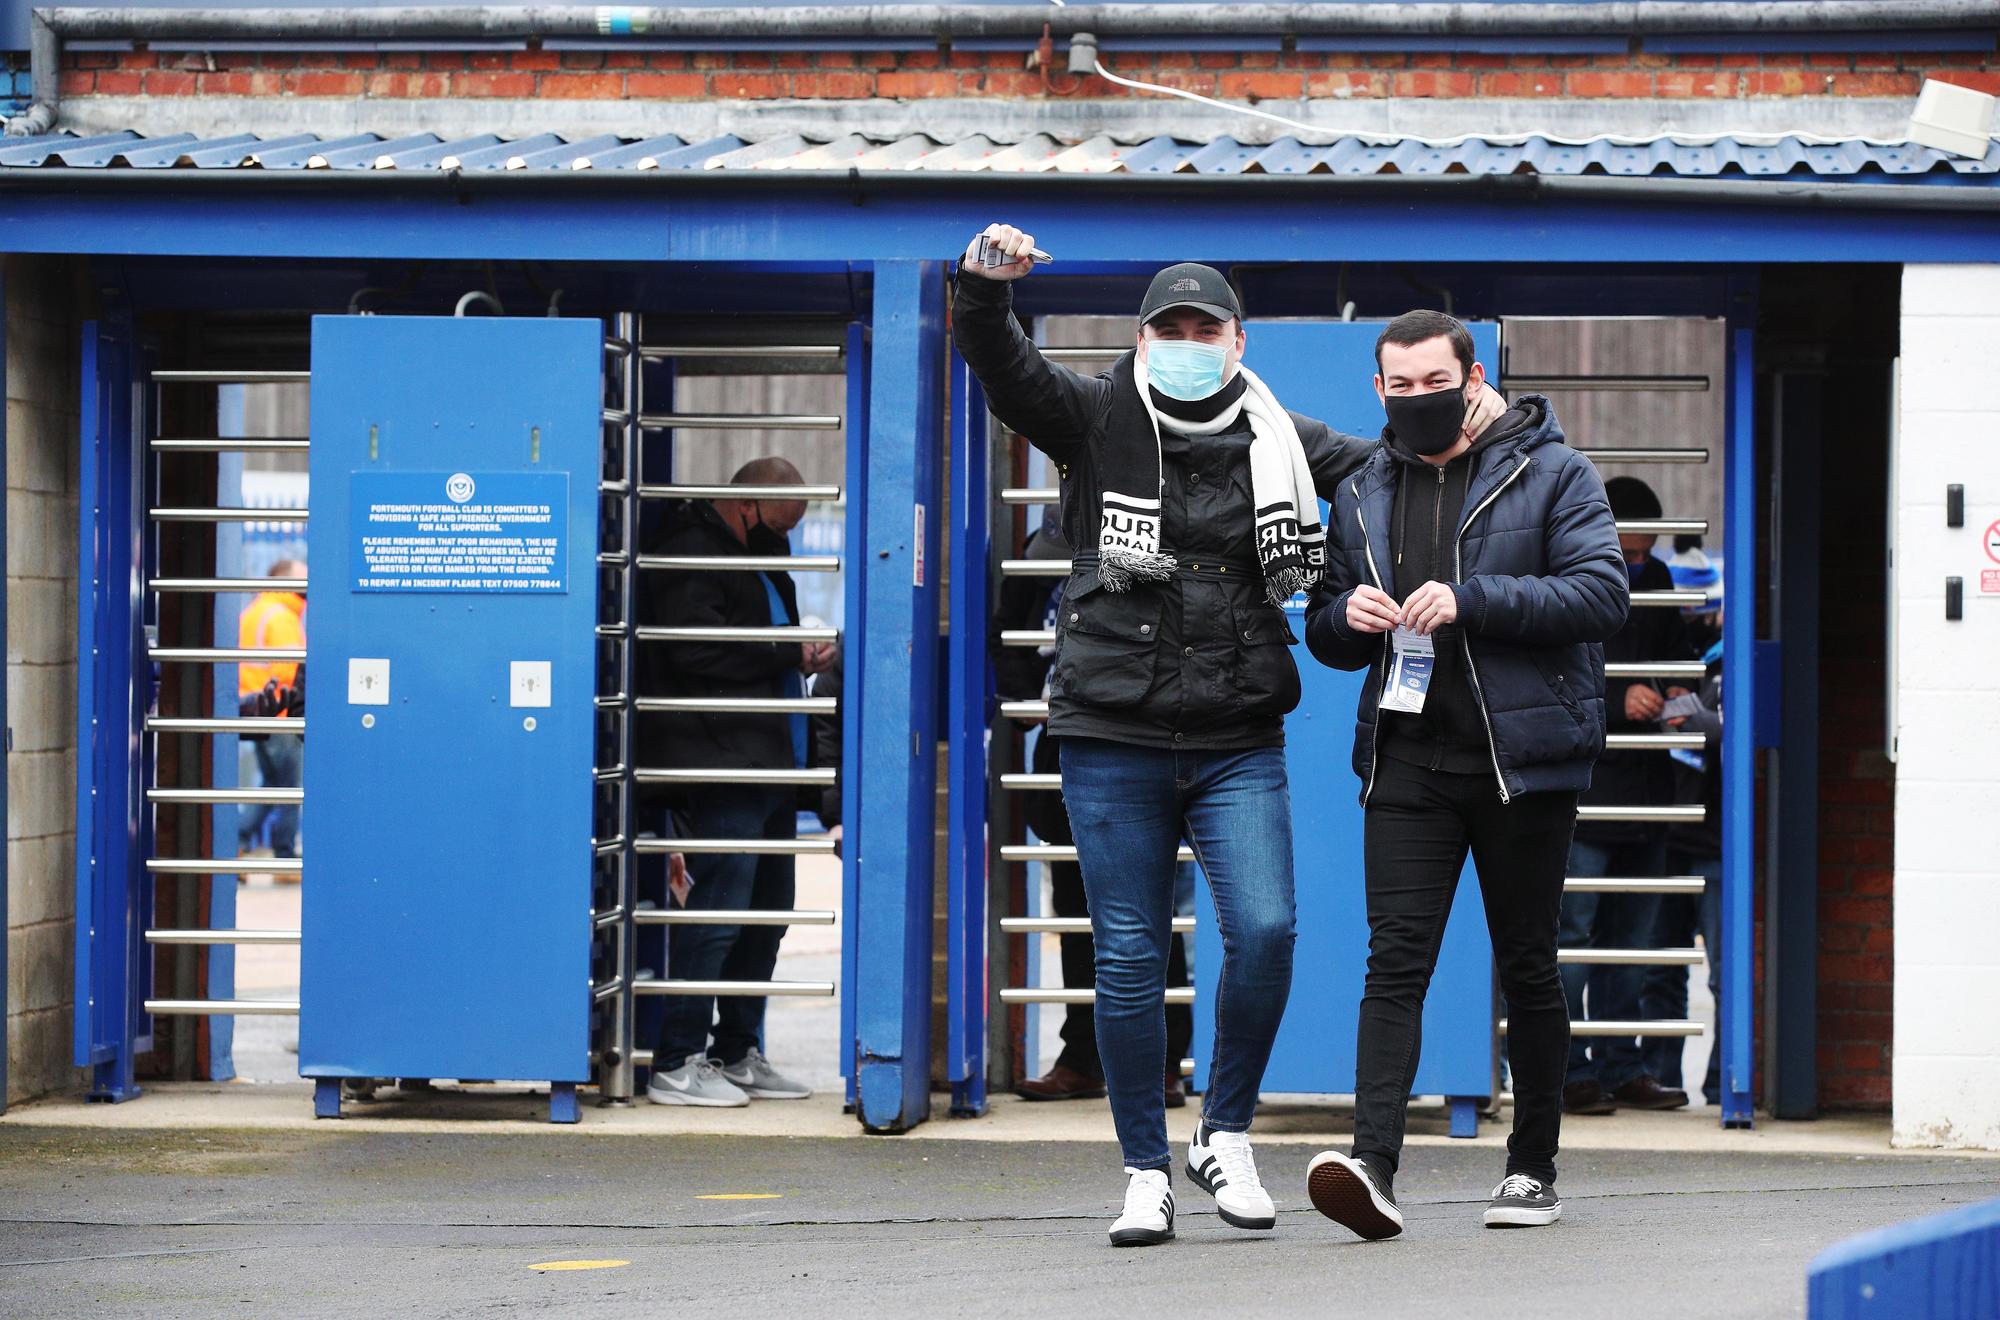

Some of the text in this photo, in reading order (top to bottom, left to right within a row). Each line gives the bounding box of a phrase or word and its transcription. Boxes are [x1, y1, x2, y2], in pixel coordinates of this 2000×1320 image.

[371, 504, 550, 514] PORTSMOUTH FOOTBALL CLUB IS COMMITTED TO
[369, 514, 412, 522] PROVIDING
[419, 514, 439, 522] SAFE
[440, 514, 456, 522] AND
[457, 514, 495, 523] FRIENDLY
[496, 514, 551, 523] ENVIRONMENT
[417, 523, 503, 533] FOR ALL SUPPORTERS.
[362, 537, 557, 547] PLEASE REMEMBER THAT POOR BEHAVIOUR, THE USE
[1103, 535, 1155, 553] ONAL
[364, 546, 555, 556] OF ABUSIVE LANGUAGE AND GESTURES WILL NOT BE
[365, 555, 554, 565] TOLERATED AND MAY LEAD TO YOU BEING EJECTED,
[370, 565, 549, 574] ARRESTED OR EVEN BANNED FROM THE GROUND.
[359, 579, 369, 587] TO
[369, 579, 400, 587] REPORT
[401, 579, 412, 587] AN
[413, 579, 451, 587] INCIDENT
[451, 579, 481, 588] PLEASE
[482, 579, 502, 588] TEXT
[502, 580, 529, 588] 07500
